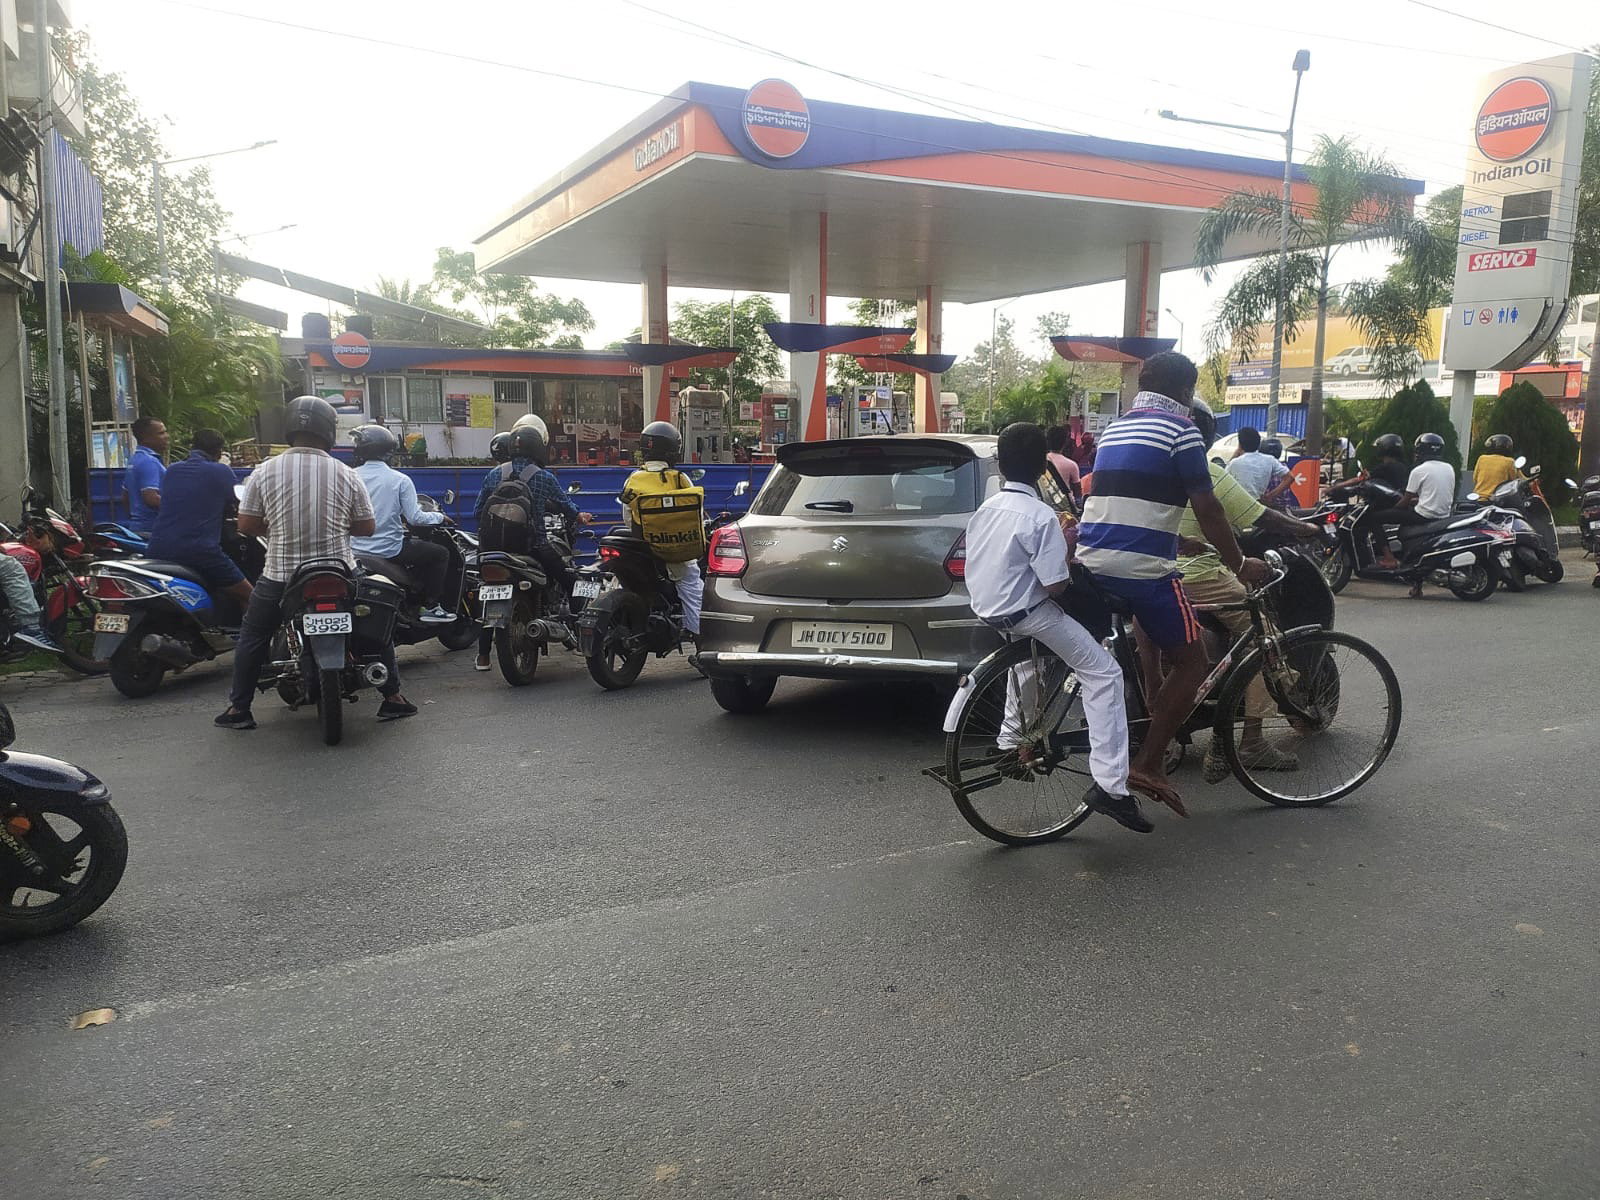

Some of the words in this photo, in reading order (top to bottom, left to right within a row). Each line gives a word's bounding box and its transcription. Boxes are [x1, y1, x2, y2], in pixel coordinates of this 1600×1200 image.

[1478, 107, 1549, 136] इंडियनऑयल
[633, 122, 678, 170] IndianOil
[1473, 158, 1551, 185] IndianOil
[1463, 205, 1495, 218] PETROL
[1461, 231, 1490, 243] DIESEL
[1471, 250, 1529, 271] SERVO
[648, 529, 700, 544] blinkit
[305, 624, 350, 634] 3992
[797, 630, 816, 642] JH
[850, 631, 887, 646] 5100
